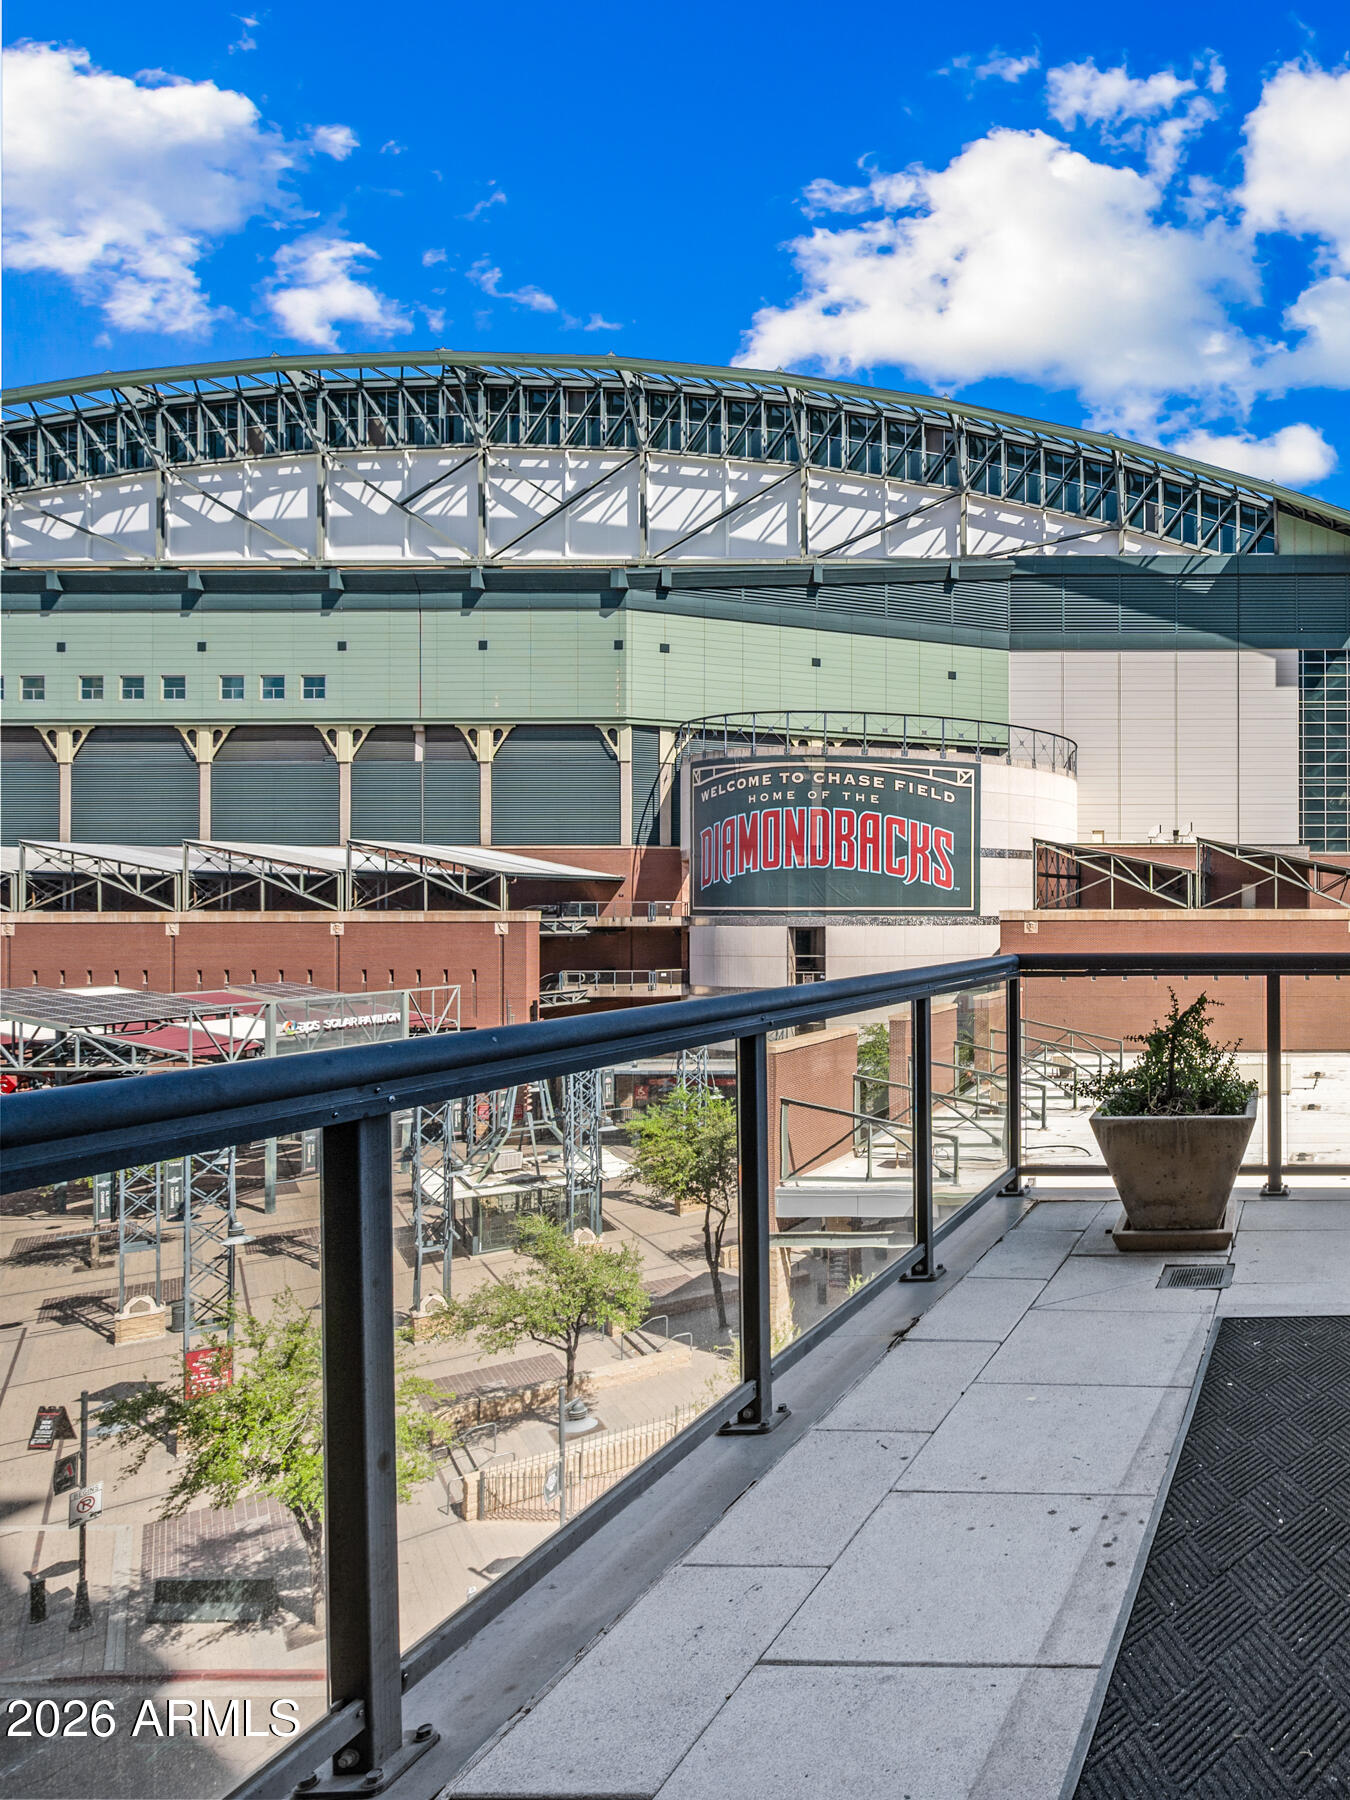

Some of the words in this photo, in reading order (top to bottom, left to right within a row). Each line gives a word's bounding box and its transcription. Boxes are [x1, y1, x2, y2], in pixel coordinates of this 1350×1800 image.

[701, 774, 772, 802] WELCOME
[779, 772, 804, 784] TO
[813, 772, 885, 788] CHASE
[894, 779, 955, 803] FIELD
[748, 791, 795, 804] HOME
[807, 790, 830, 800] OF
[842, 791, 879, 803] THE
[700, 806, 955, 891] DIAMONDBACKS
[323, 1016, 358, 1031] SOLAR
[358, 1012, 401, 1027] PAVILION
